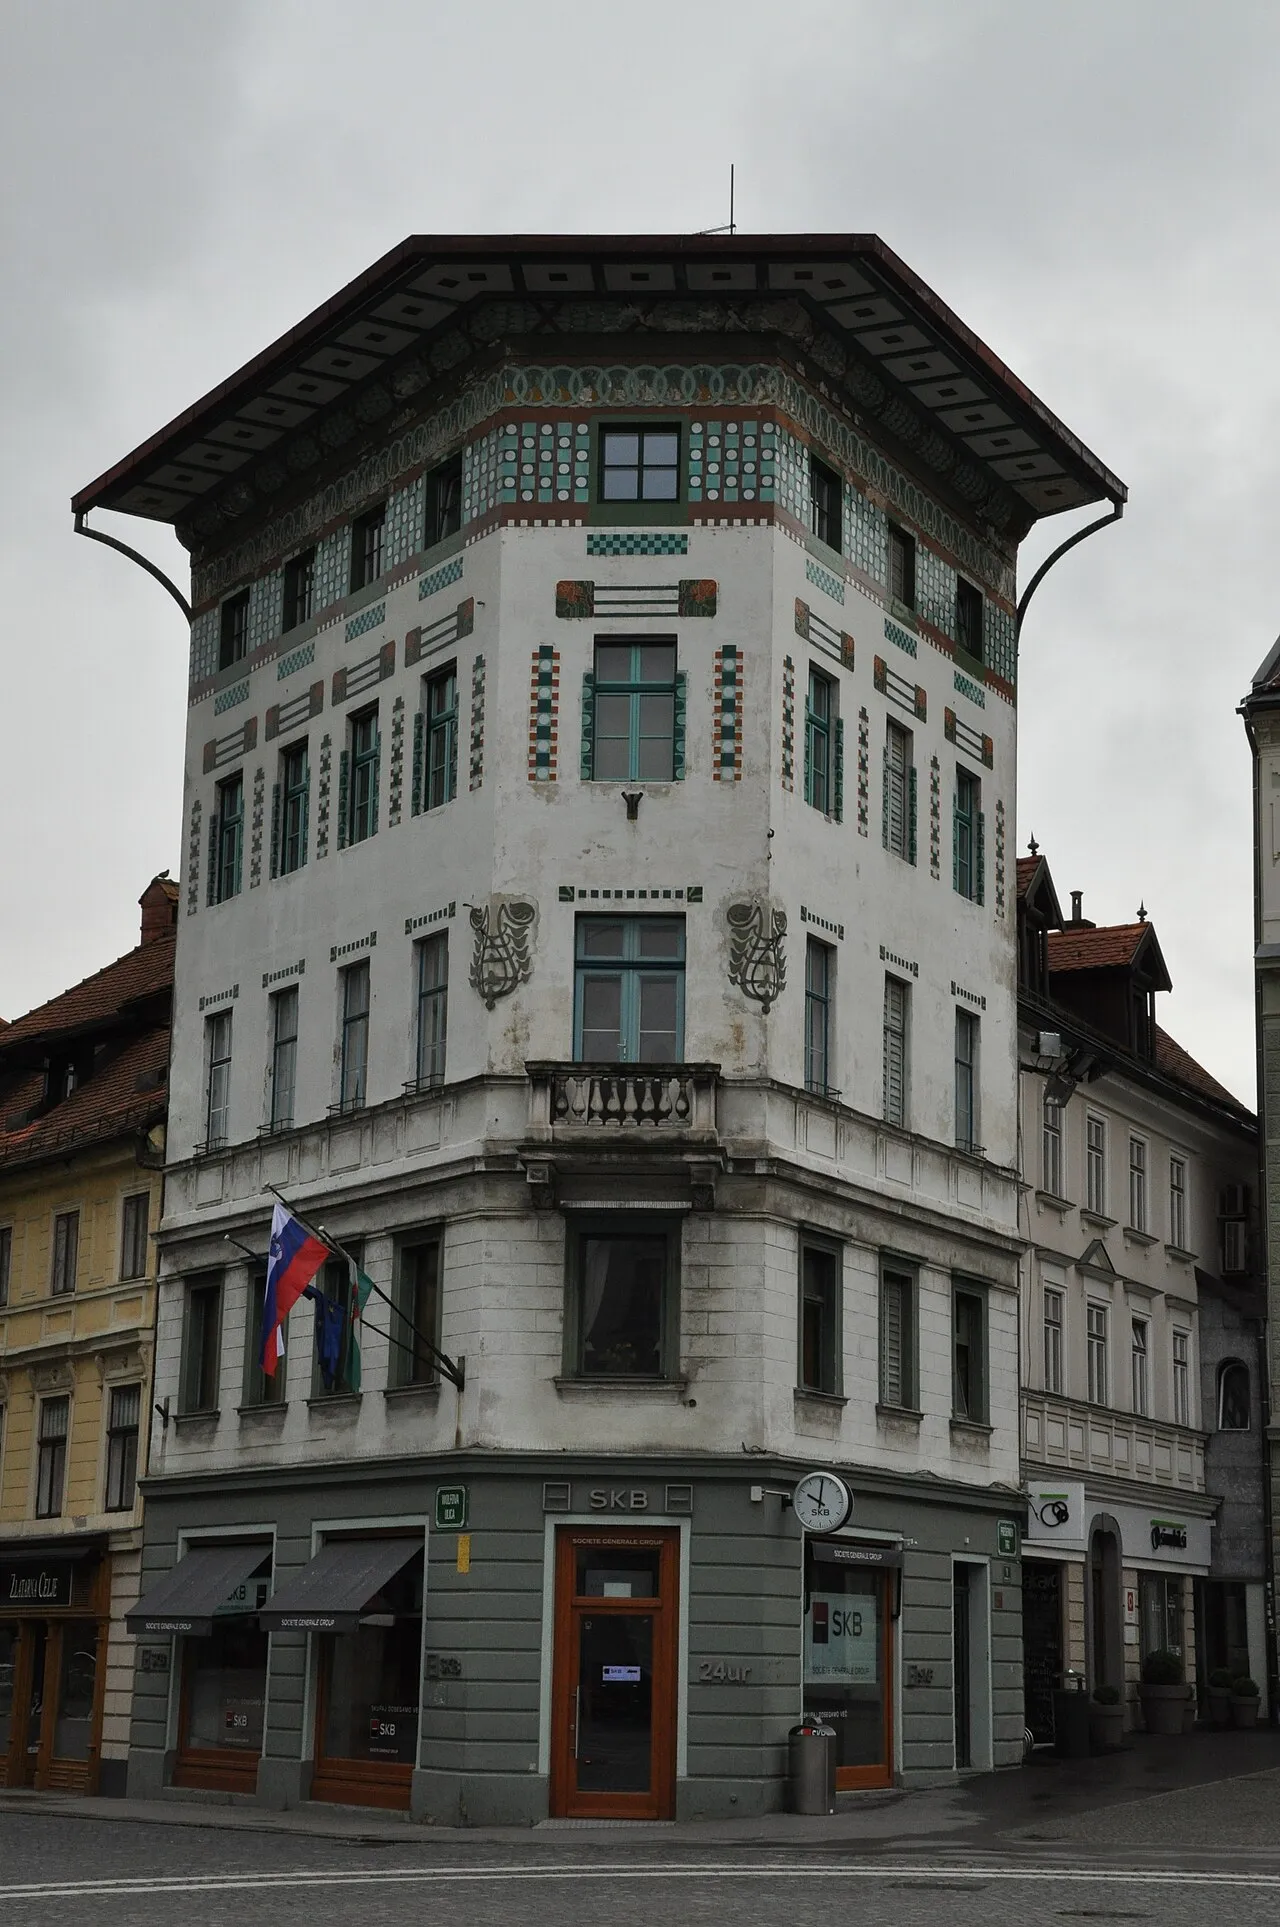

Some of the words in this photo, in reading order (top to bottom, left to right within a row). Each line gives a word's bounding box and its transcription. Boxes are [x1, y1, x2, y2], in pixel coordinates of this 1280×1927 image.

[589, 1488, 648, 1509] SKB
[811, 1508, 830, 1516] SKB
[832, 1610, 862, 1637] SKB
[699, 1660, 752, 1682] 24ur
[233, 1714, 248, 1727] SKB
[379, 1722, 396, 1736] SKB
